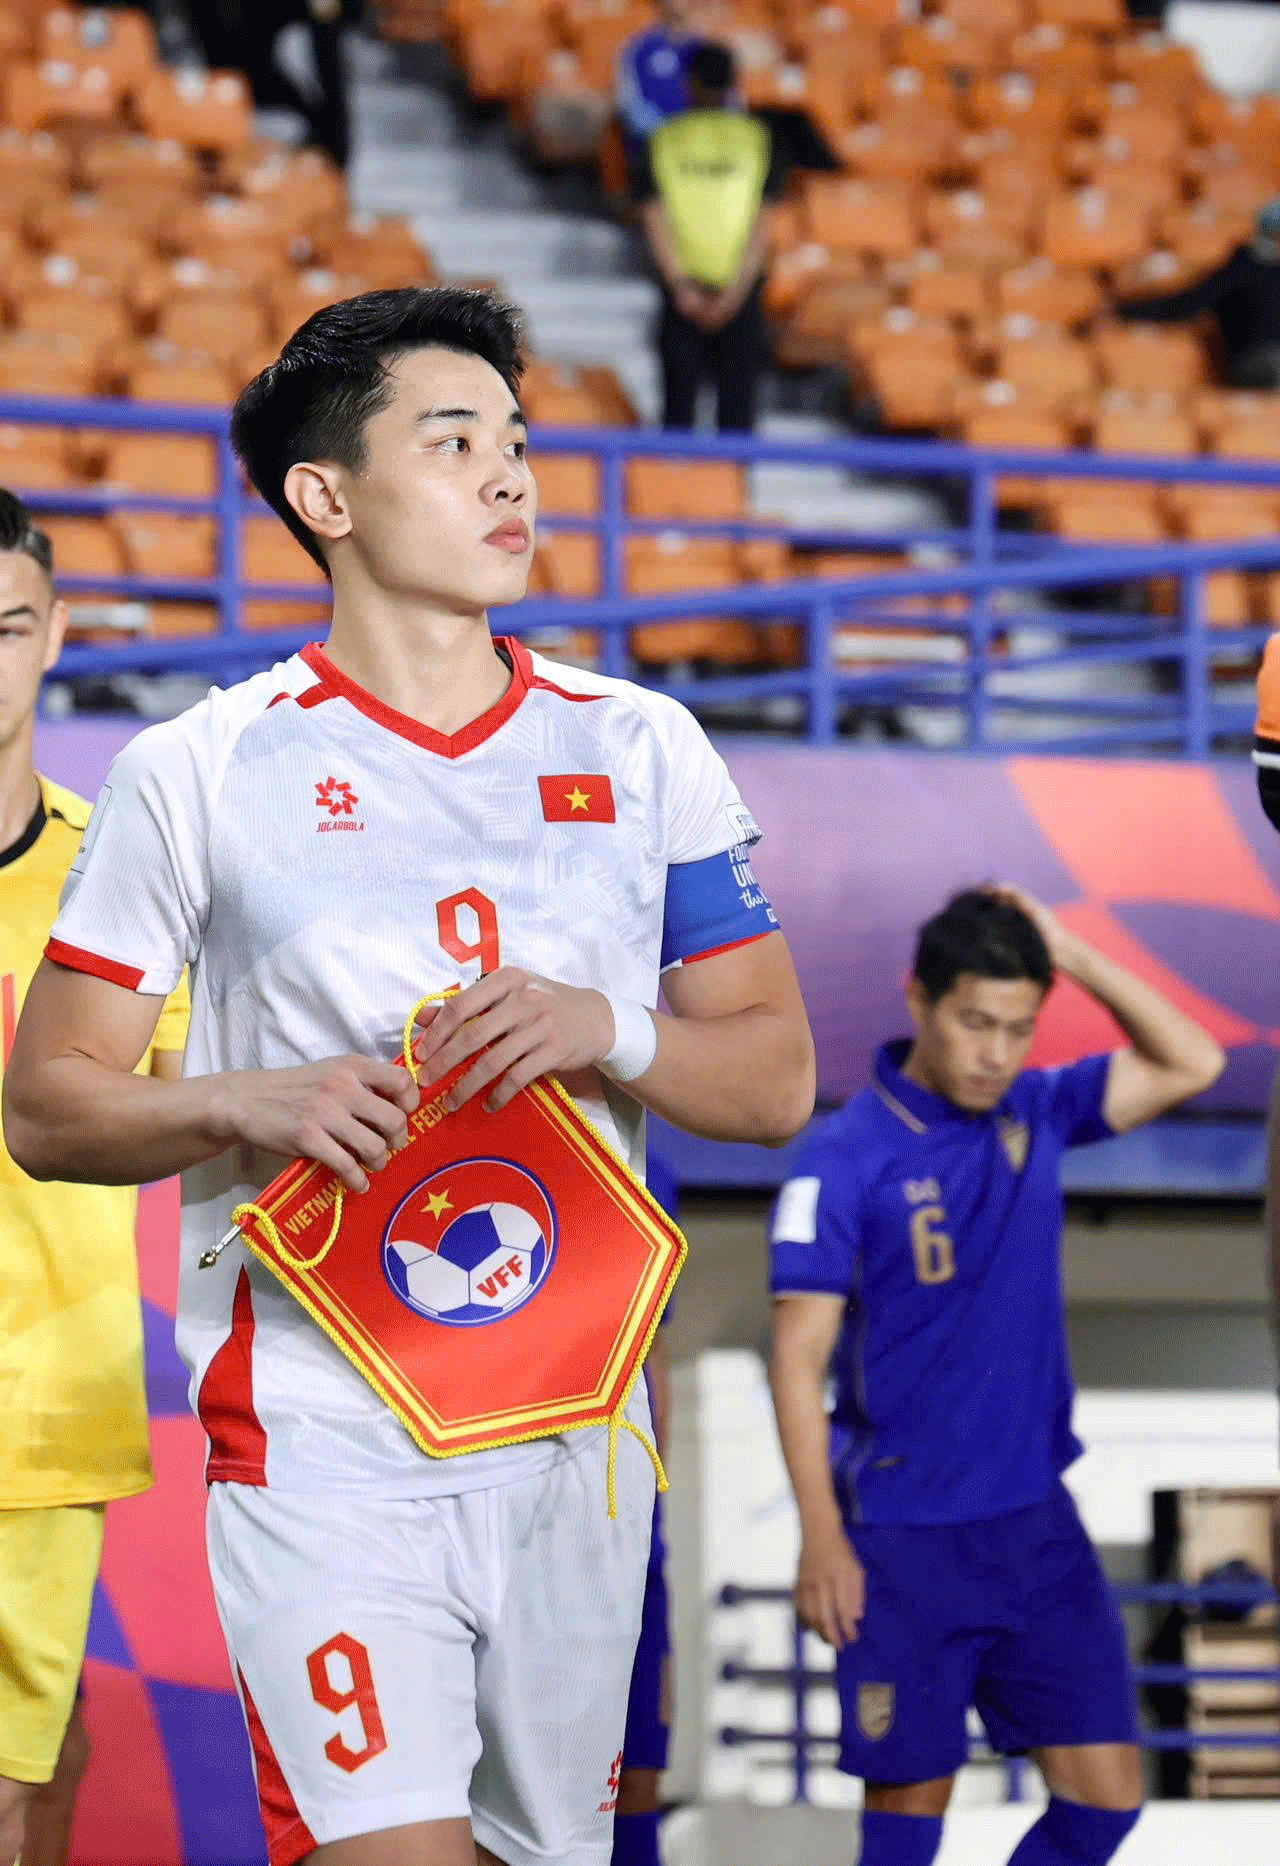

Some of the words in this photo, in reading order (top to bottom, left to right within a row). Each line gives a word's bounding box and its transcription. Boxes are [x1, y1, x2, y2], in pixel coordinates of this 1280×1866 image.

[436, 886, 500, 993] 9
[476, 1254, 523, 1299] VFF
[909, 1205, 957, 1285] 6
[306, 1631, 389, 1774] 9
